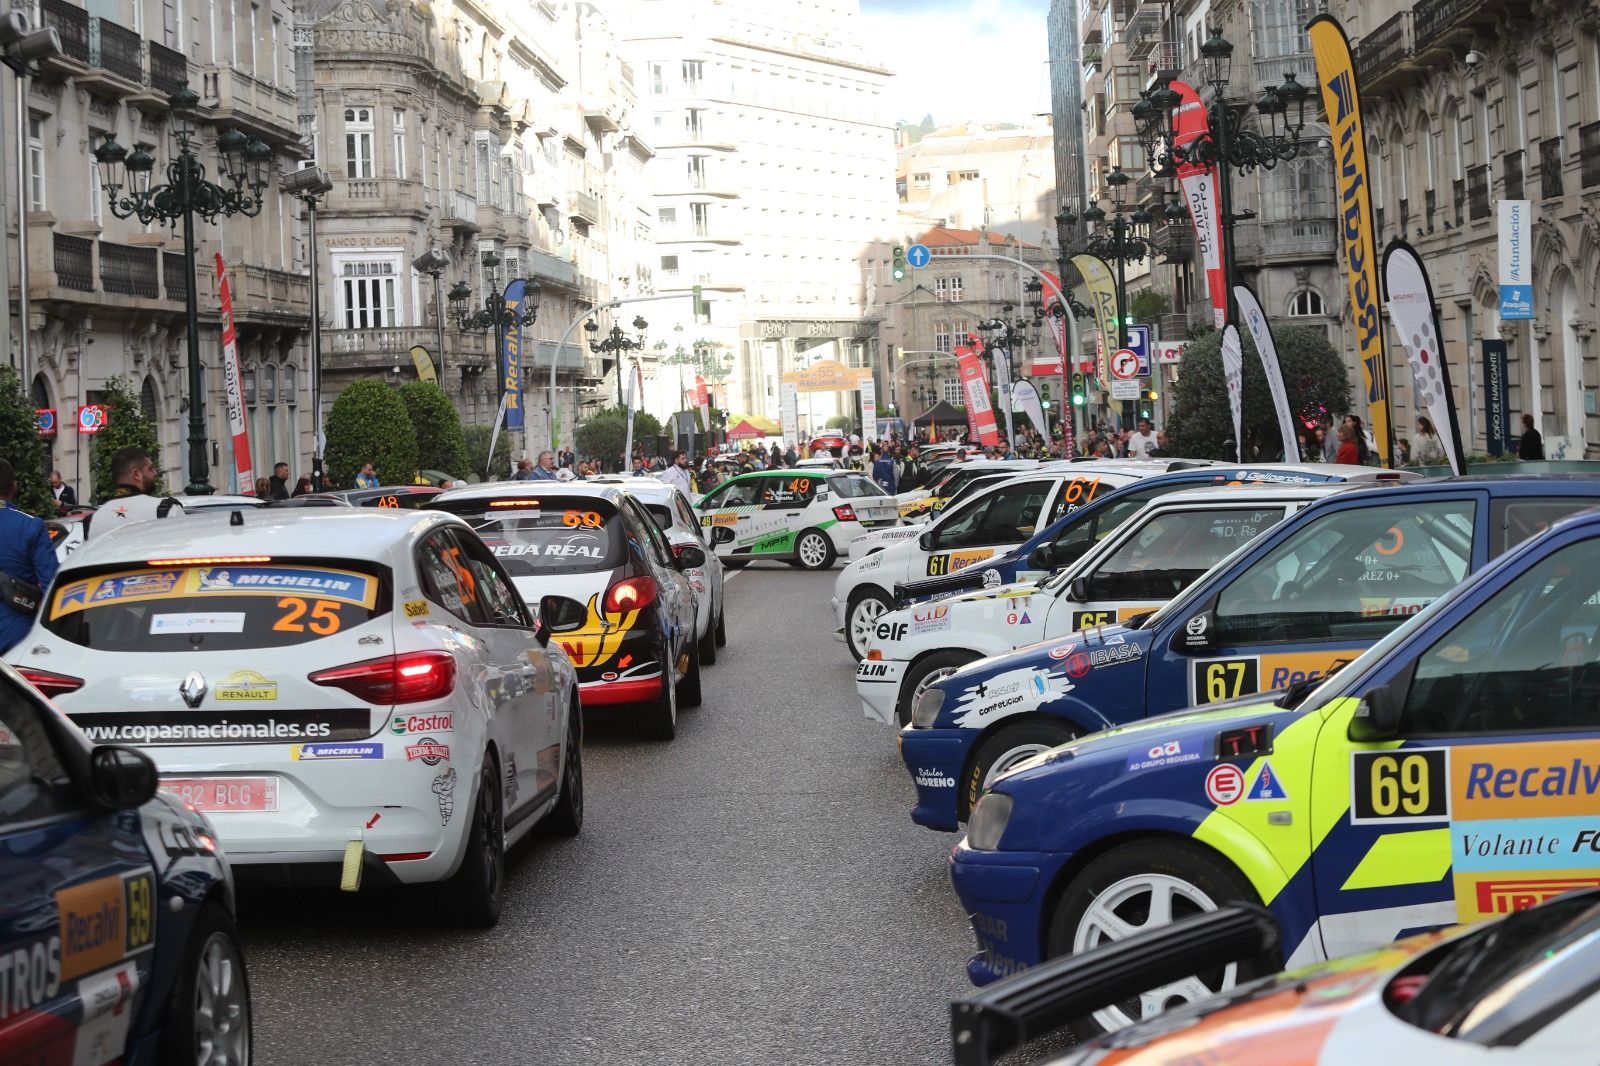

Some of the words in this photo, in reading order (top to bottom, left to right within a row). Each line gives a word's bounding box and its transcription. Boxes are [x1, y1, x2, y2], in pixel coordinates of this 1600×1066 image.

[374, 236, 407, 246] GALICIA
[1489, 352, 1500, 401] NAVEGANTE
[1492, 402, 1500, 413] DE
[789, 478, 810, 494] 49
[1065, 476, 1101, 503] 61
[378, 495, 399, 510] 48
[563, 509, 601, 527] 60
[701, 516, 711, 526] 49
[544, 544, 605, 559] REAL
[760, 535, 789, 550] MPR
[930, 556, 945, 575] 61
[237, 574, 351, 591] MICHELIN
[272, 597, 342, 636] 25
[877, 622, 908, 641] elf
[1090, 643, 1142, 666] IBASA
[1206, 662, 1246, 704] 67
[222, 690, 270, 698] RENAULT
[407, 713, 454, 733] Castrol
[316, 747, 374, 755] MICHELIN
[1130, 763, 1141, 771] AD
[1141, 758, 1165, 769] GRUPO
[1167, 753, 1200, 764] REGUEIRA
[916, 777, 955, 788] MORENO
[1215, 773, 1236, 792] E
[1370, 755, 1430, 816] 69
[215, 784, 251, 805] BCG
[1463, 833, 1560, 857] Volante
[129, 877, 151, 948] 59
